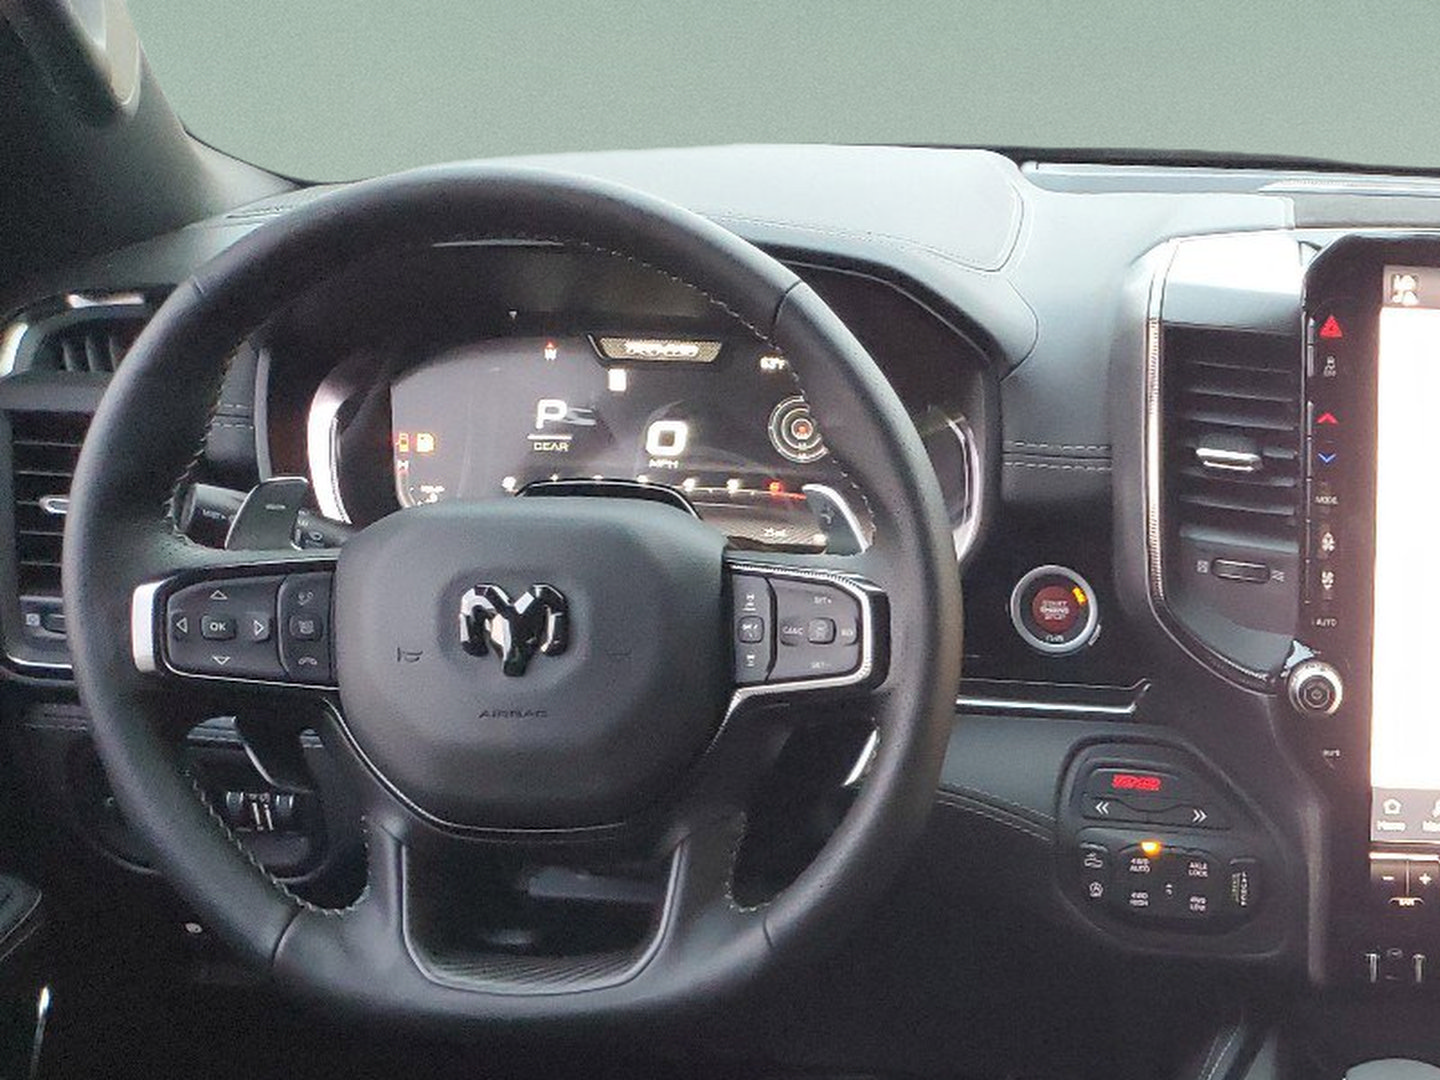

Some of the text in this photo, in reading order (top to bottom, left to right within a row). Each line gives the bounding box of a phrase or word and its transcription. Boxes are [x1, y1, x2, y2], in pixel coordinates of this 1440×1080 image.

[536, 399, 567, 430] P
[533, 441, 569, 452] GEAR
[209, 622, 228, 632] OK
